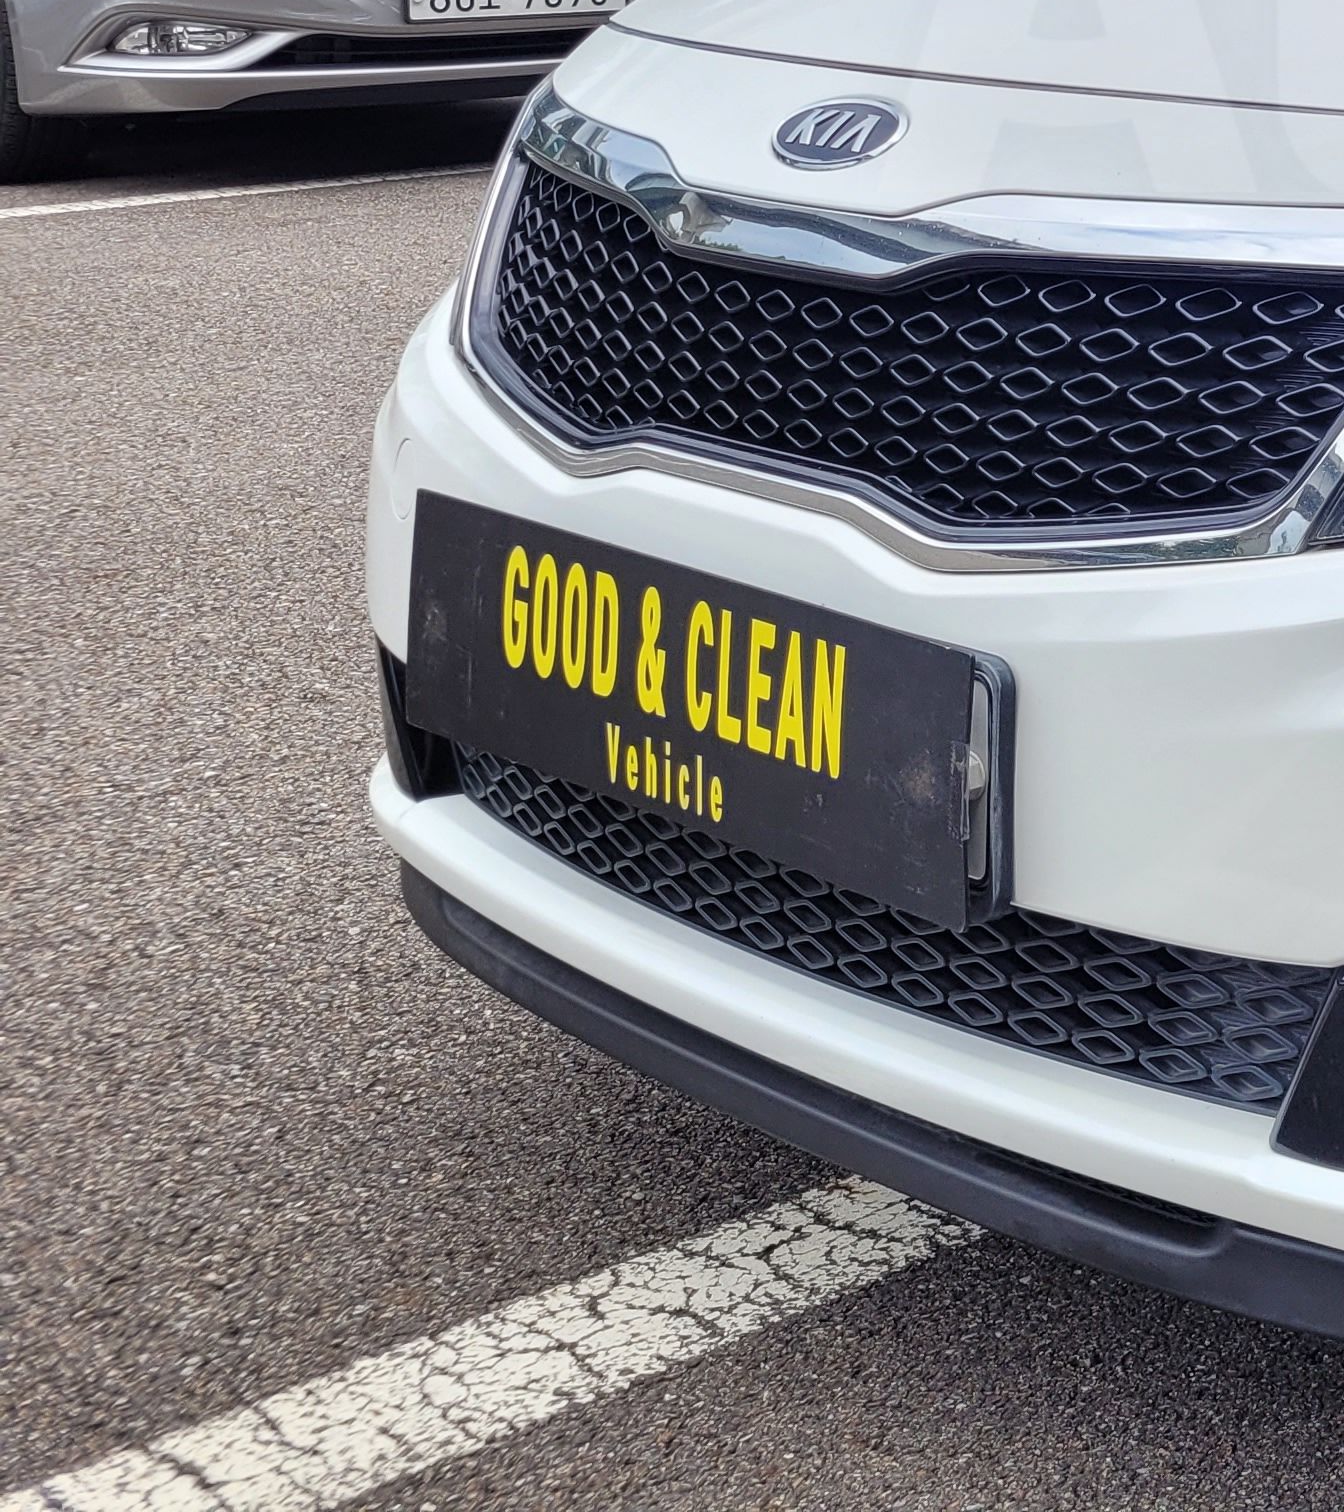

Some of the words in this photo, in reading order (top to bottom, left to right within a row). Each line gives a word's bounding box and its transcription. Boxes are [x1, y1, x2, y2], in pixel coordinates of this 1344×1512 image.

[785, 108, 882, 153] KIA
[502, 545, 621, 698] GOOD
[636, 585, 667, 718] &
[686, 600, 847, 780] CLEAN
[606, 722, 724, 823] Vehicle
